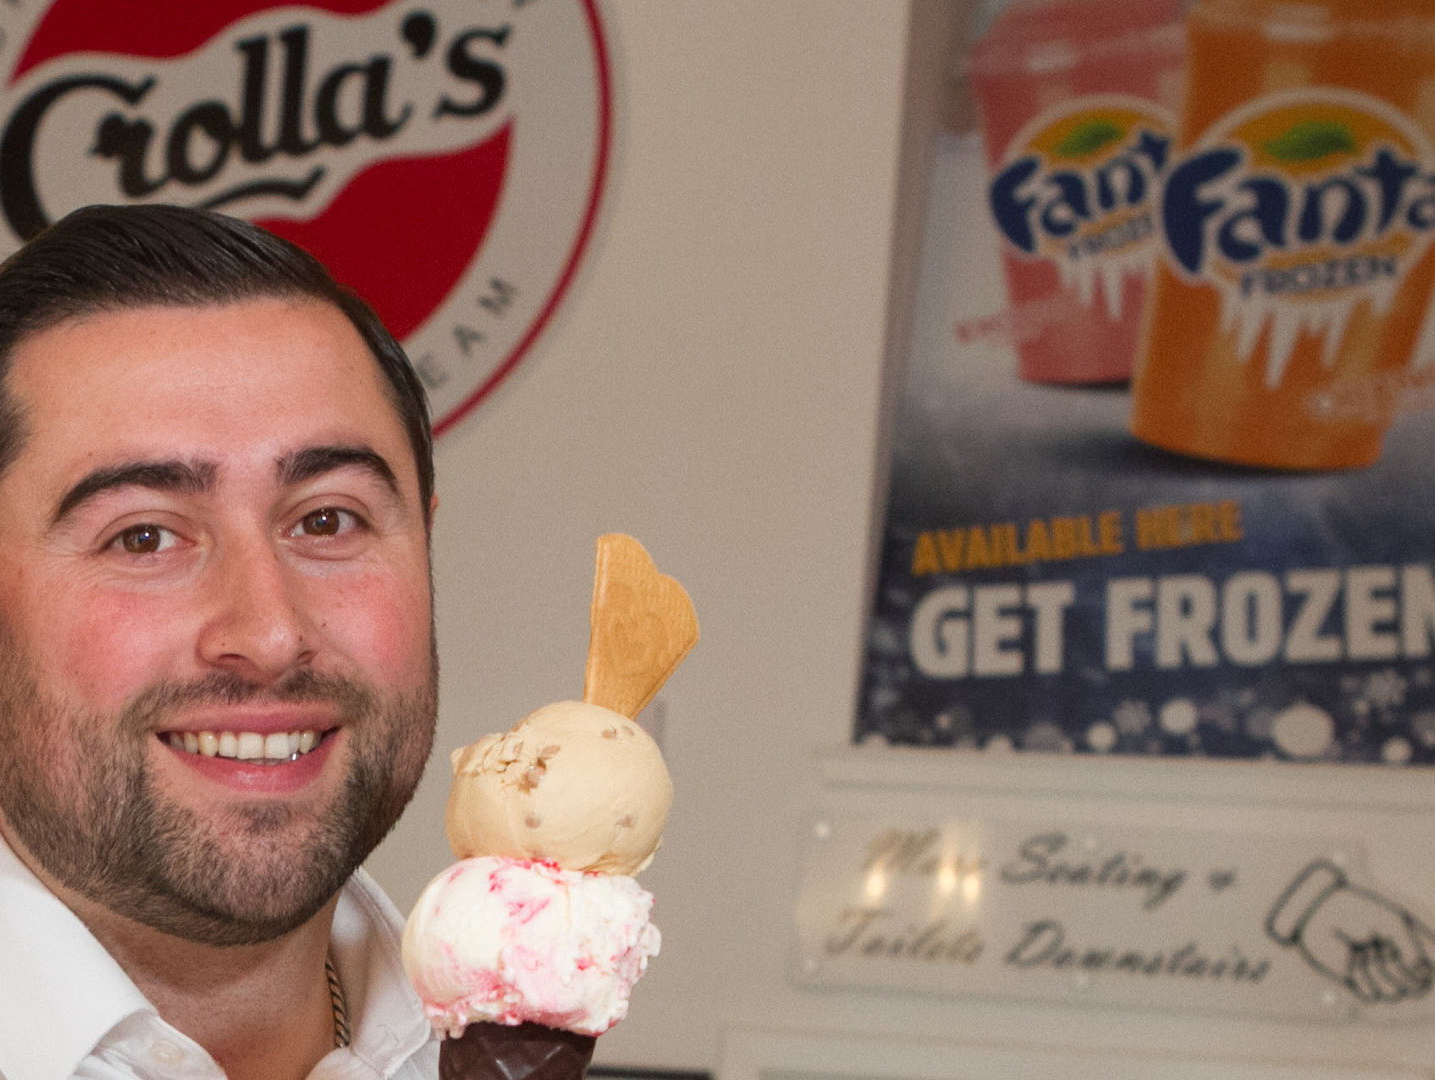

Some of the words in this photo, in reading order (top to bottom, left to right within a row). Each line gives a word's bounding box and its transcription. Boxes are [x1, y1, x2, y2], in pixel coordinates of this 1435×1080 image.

[989, 131, 1169, 255] Fant
[1239, 254, 1397, 298] FROZEN
[911, 511, 1124, 577] AVAILABLE
[1135, 499, 1243, 552] HERE
[909, 580, 1075, 680] GET
[998, 830, 1187, 912] Seating
[1004, 918, 1271, 984] Downstairs
